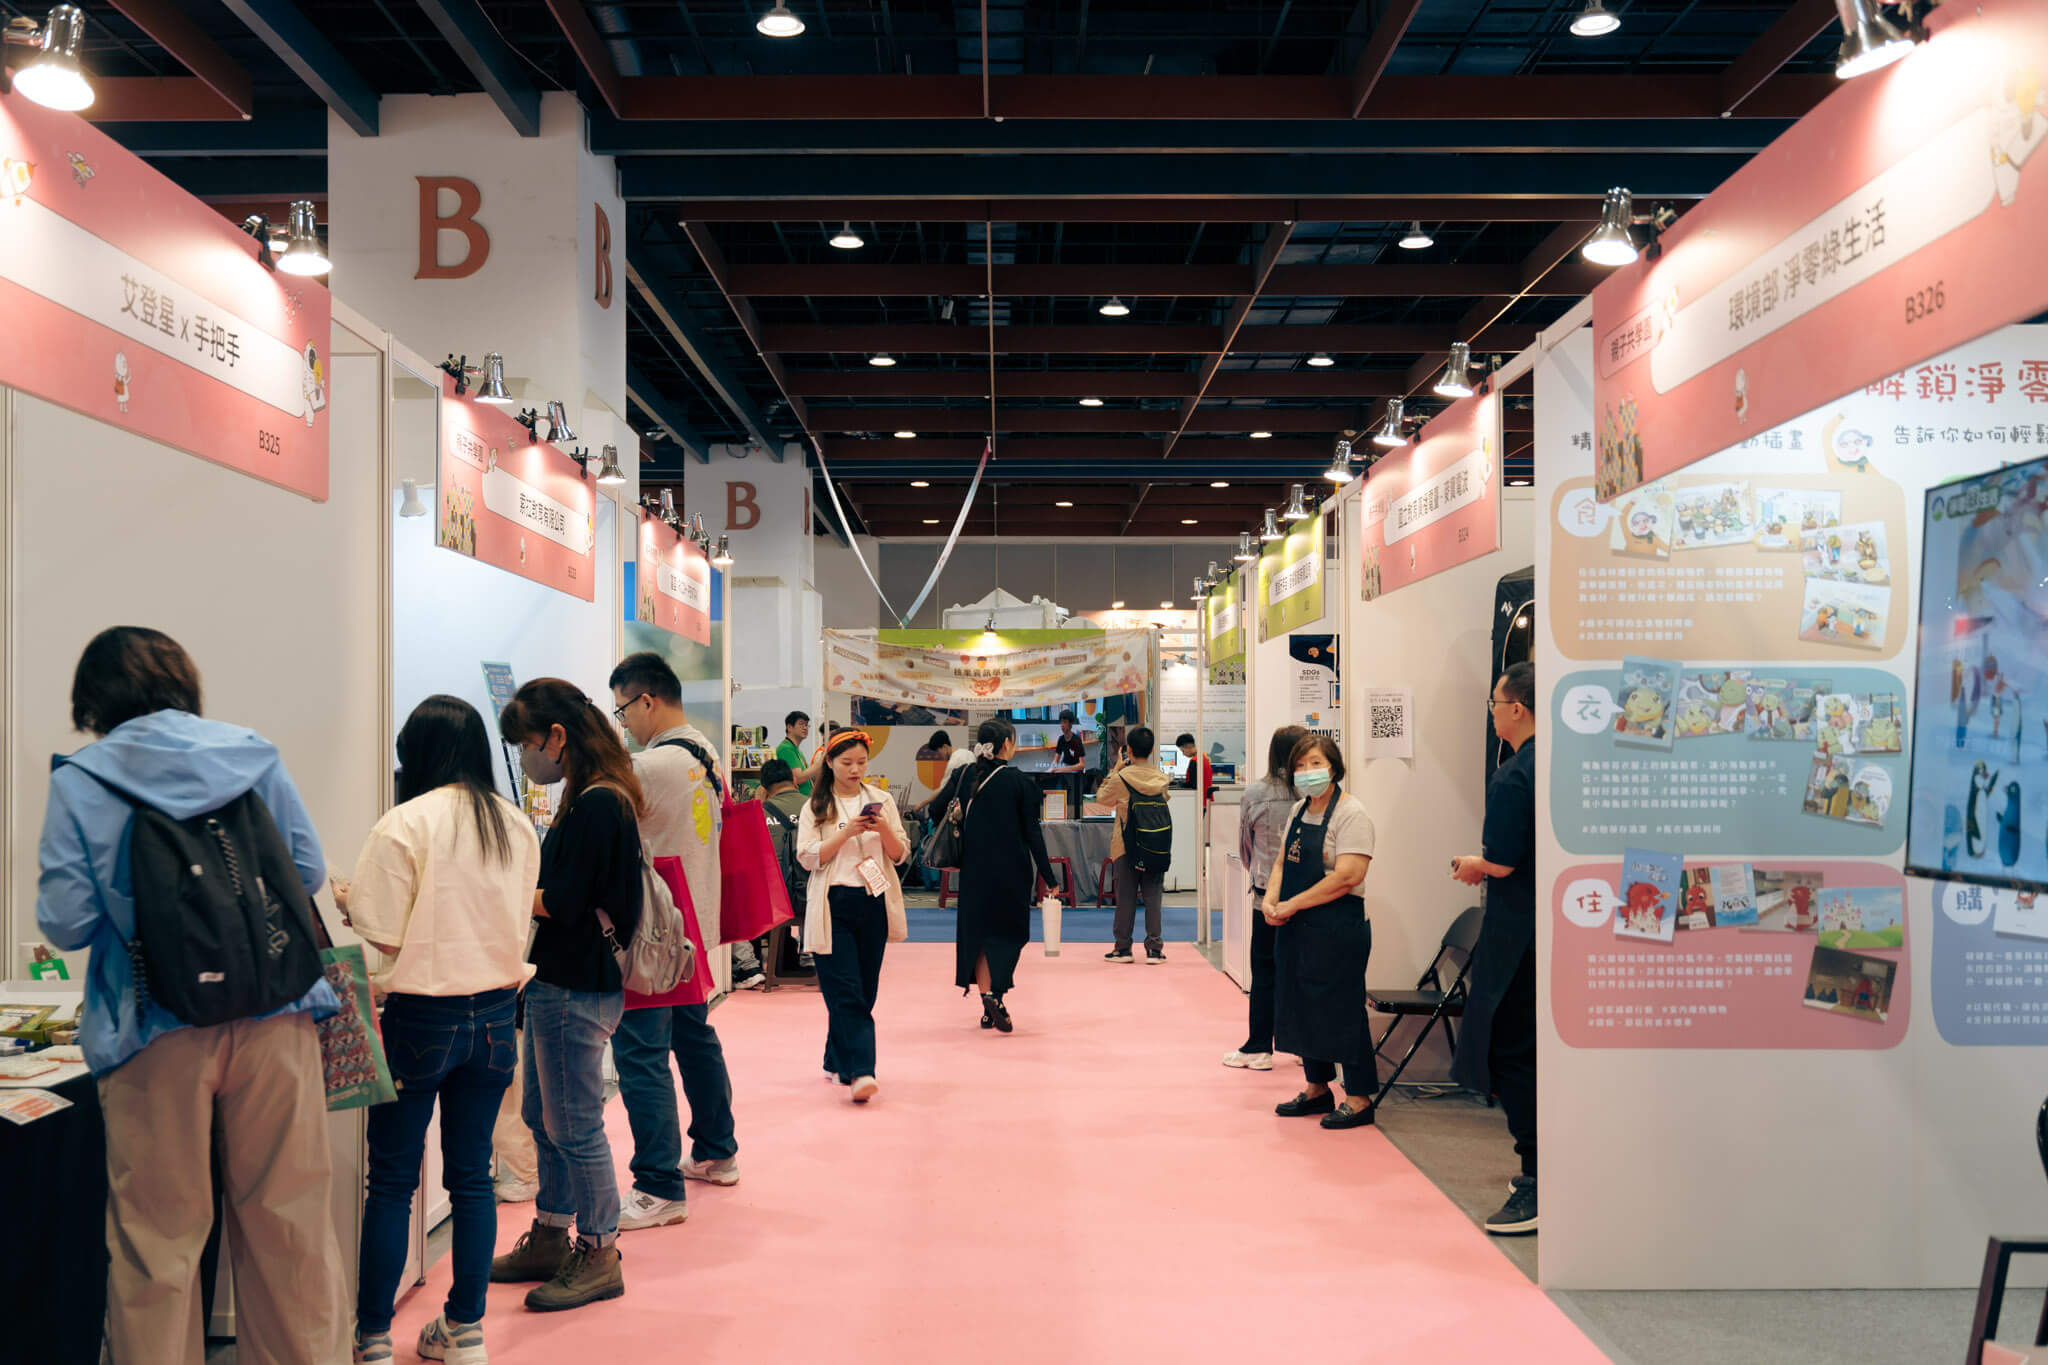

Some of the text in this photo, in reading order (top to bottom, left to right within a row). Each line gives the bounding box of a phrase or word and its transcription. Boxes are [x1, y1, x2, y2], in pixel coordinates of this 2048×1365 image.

[414, 175, 491, 280] B
[594, 201, 613, 310] B
[1729, 198, 1886, 331] 環境部 淨零綠生活
[121, 272, 175, 337] 艾登星
[194, 314, 240, 368] 手把手
[1905, 281, 1945, 325] B326
[259, 430, 281, 456] B325
[1571, 431, 1592, 450] 精
[725, 481, 761, 530] B
[1576, 889, 1603, 914] 住
[1956, 885, 1984, 912] 購
